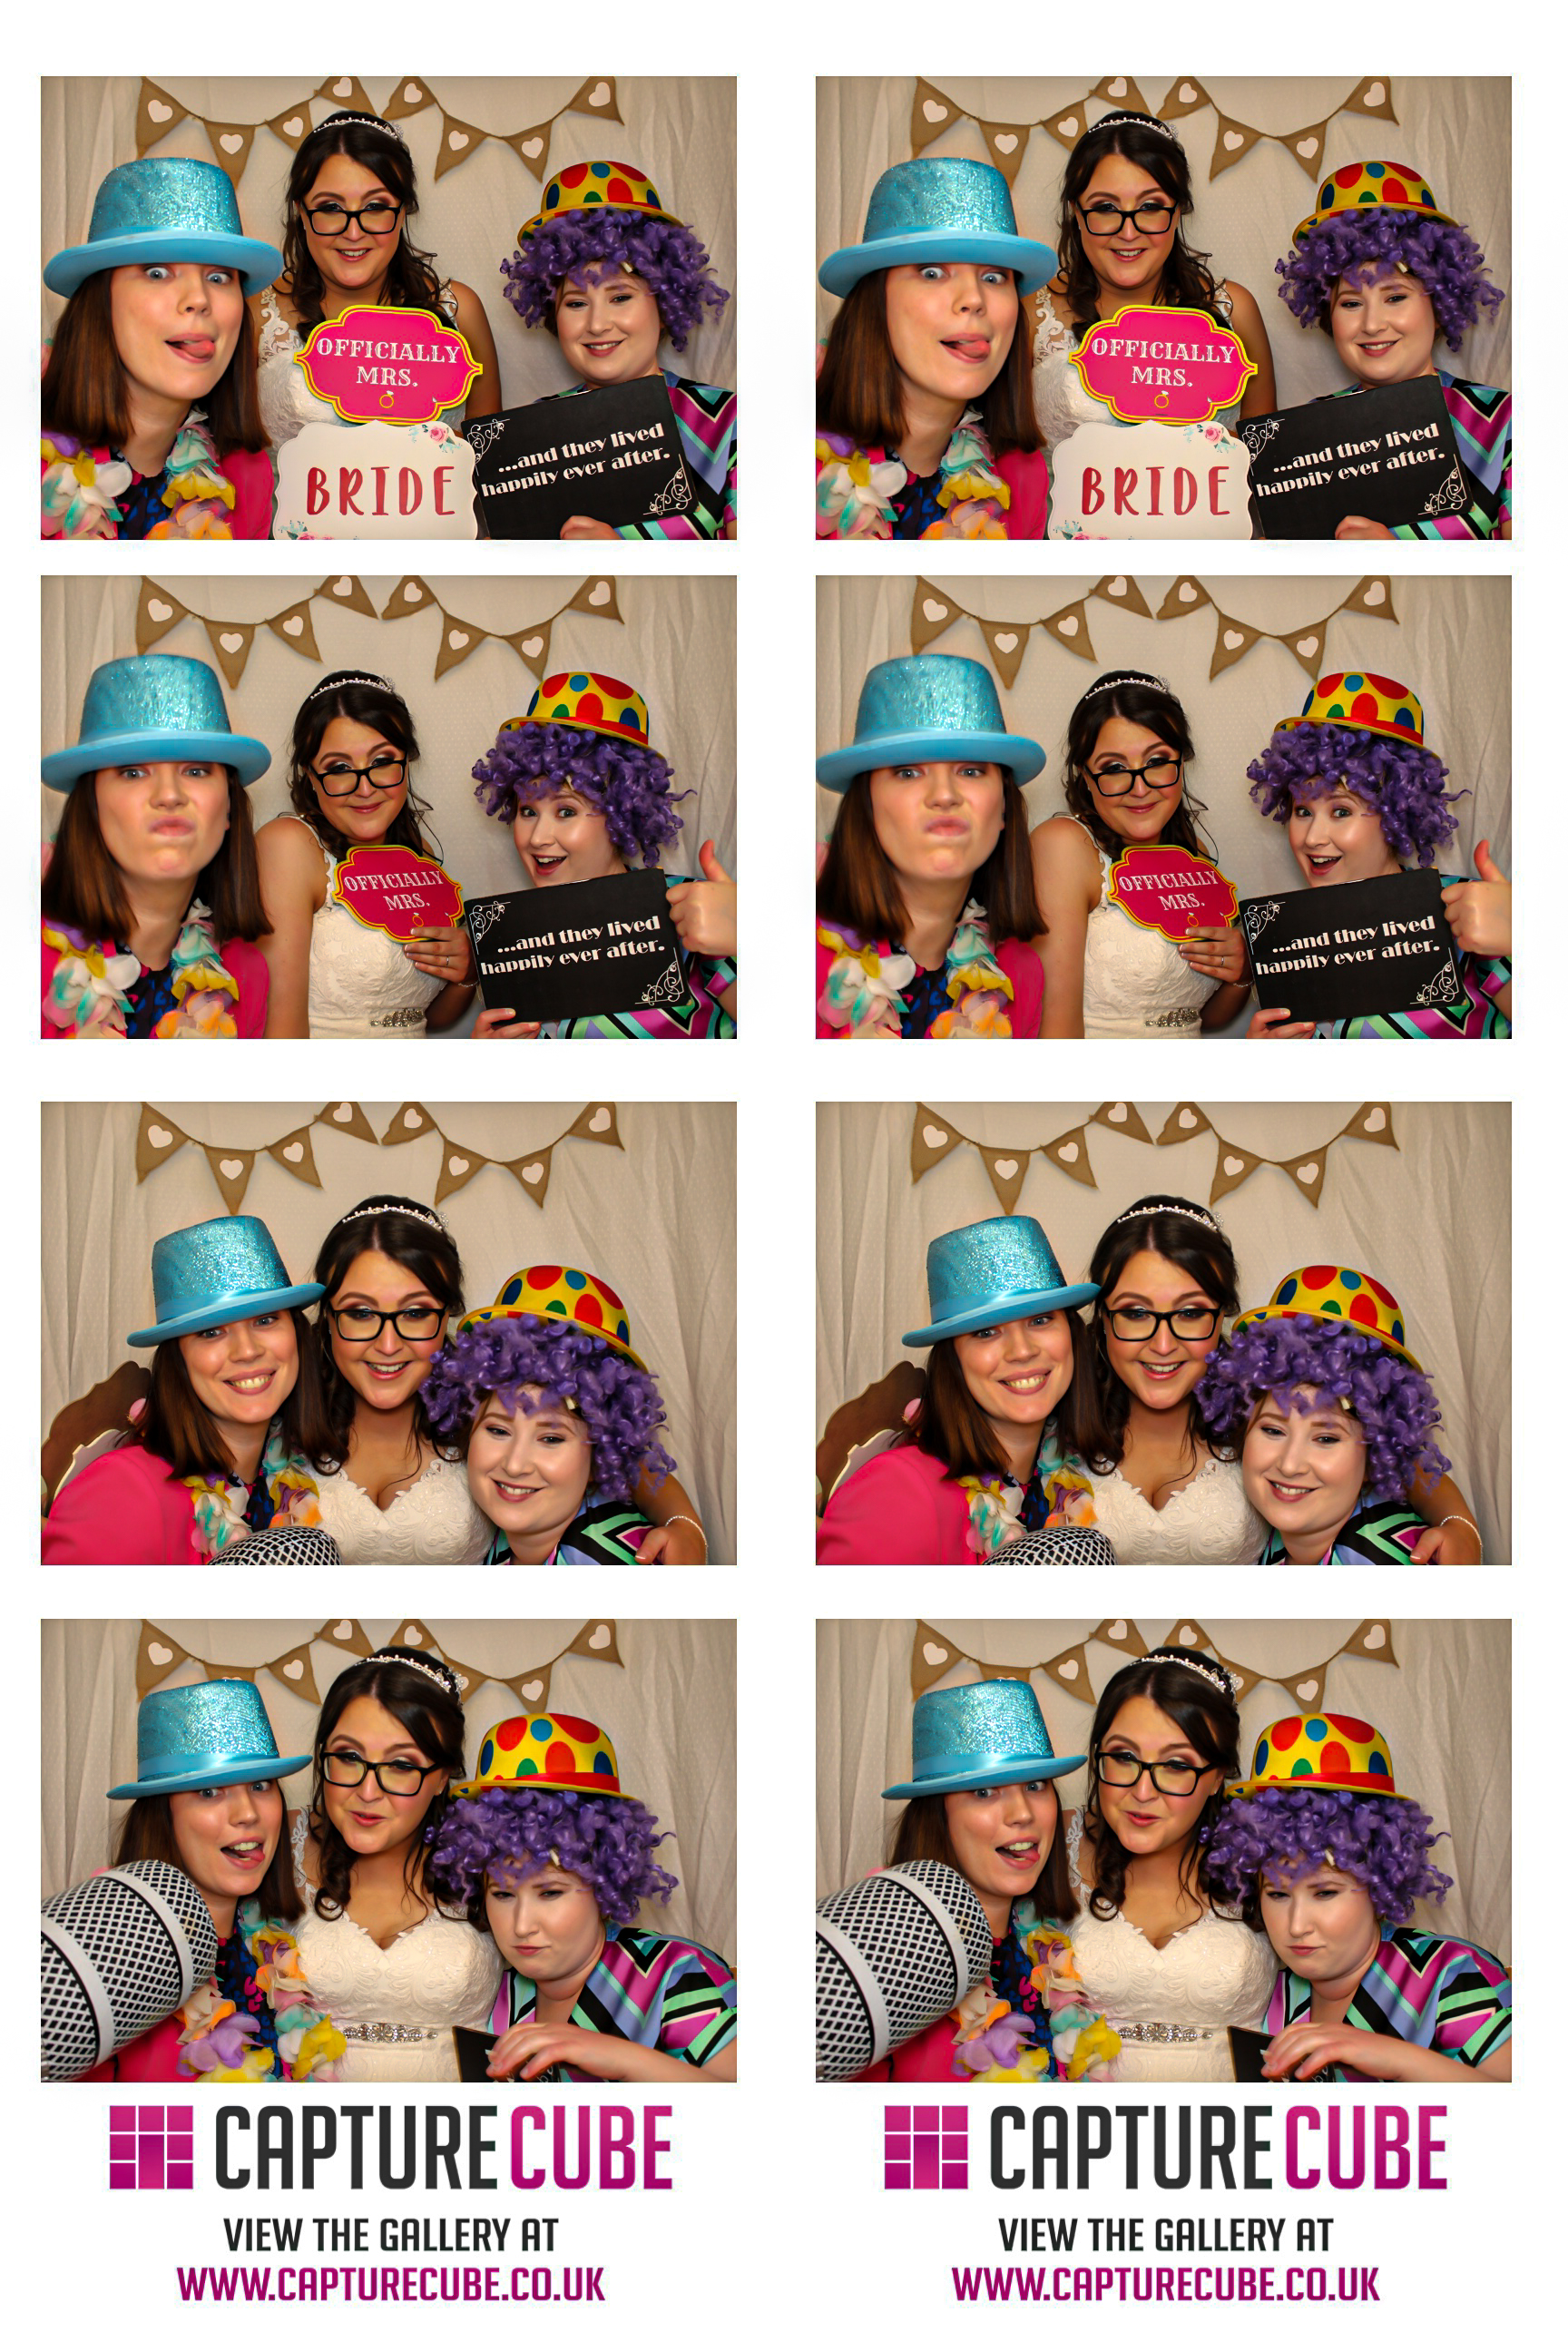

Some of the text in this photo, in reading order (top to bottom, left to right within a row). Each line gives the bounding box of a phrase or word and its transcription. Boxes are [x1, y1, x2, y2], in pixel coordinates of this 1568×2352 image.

[316, 337, 461, 364] OFFICIALLY
[1091, 337, 1236, 364] OFFICIALLY
[356, 365, 418, 387] MRS.
[1131, 365, 1193, 387] MRS.
[498, 423, 665, 473] ...and they lived
[1273, 423, 1440, 473] ...and they lived
[306, 466, 456, 516] BRIDE
[481, 446, 671, 497] happily ever after.
[1081, 466, 1230, 516] BRIDE
[1256, 446, 1446, 497] happily ever after.
[344, 870, 445, 892] OFFICIALLY
[1119, 870, 1220, 892] OFFICIALLY
[383, 892, 431, 911] MRS.
[1158, 892, 1206, 911] MRS.
[496, 915, 662, 955] ...and they lived
[1271, 915, 1436, 955] ...and they lived
[481, 936, 666, 975] happily ever after.
[1256, 936, 1441, 975] happily ever after.
